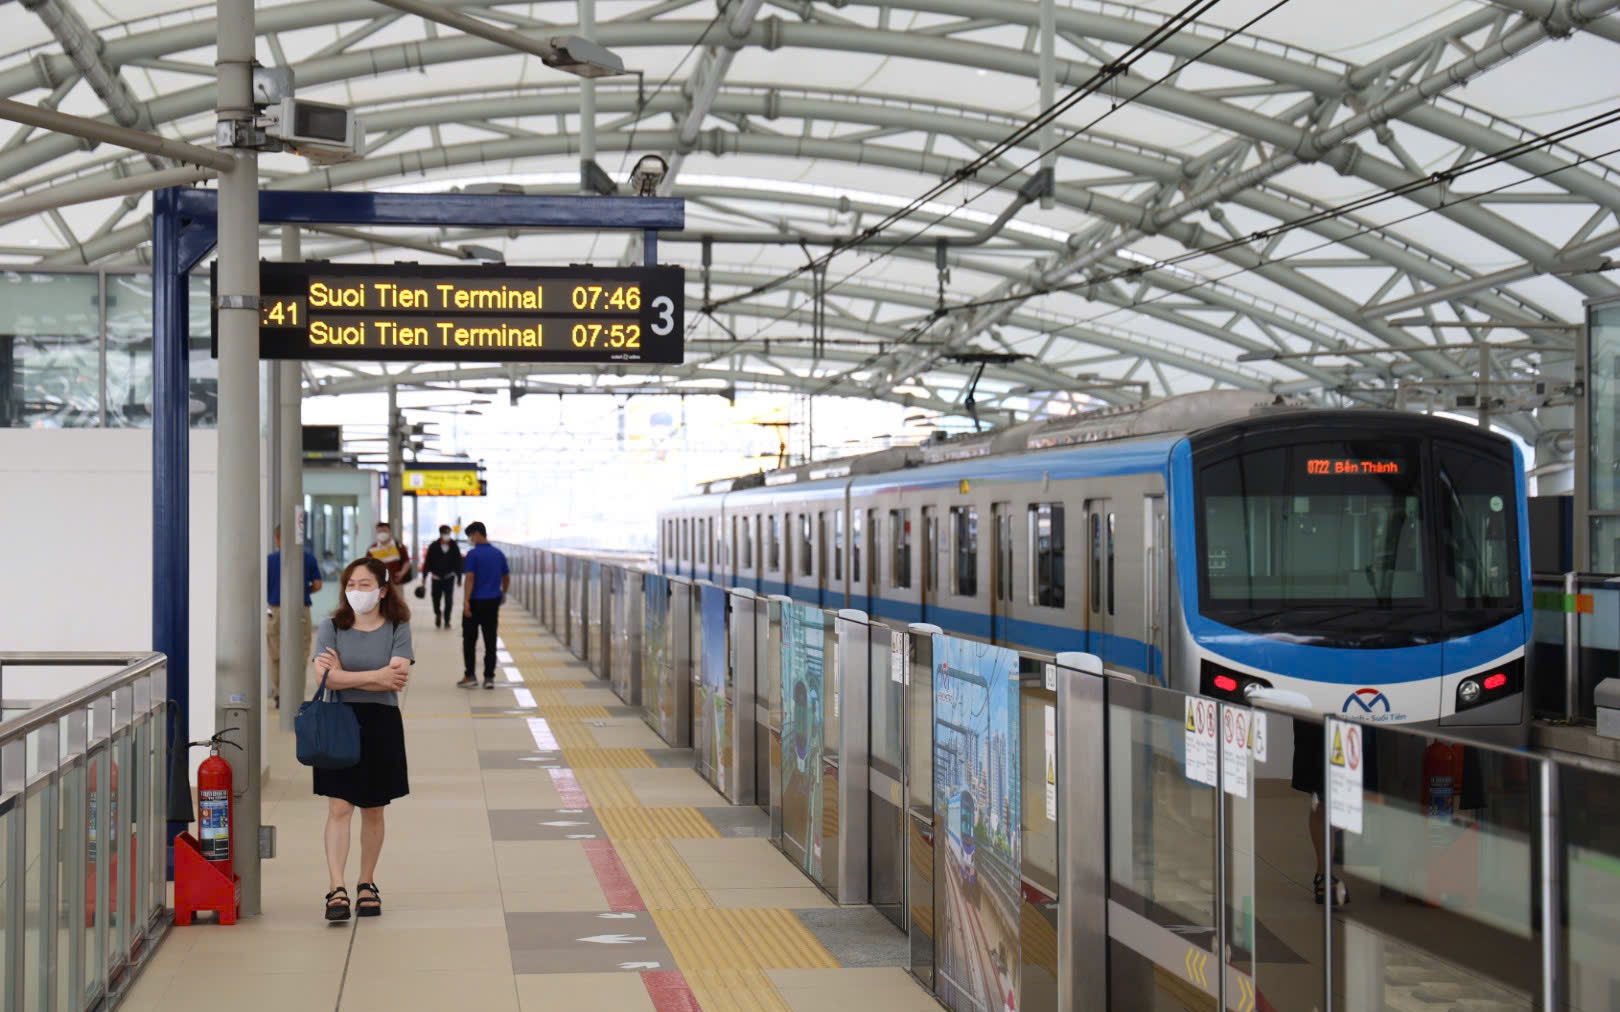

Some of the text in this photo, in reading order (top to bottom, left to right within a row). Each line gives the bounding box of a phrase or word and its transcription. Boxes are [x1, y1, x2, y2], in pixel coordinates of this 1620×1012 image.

[309, 283, 641, 310] Suoi Tien Terminal 07:46
[263, 302, 298, 326] :41
[651, 296, 675, 336] 3
[309, 321, 641, 348] Suoi Tien Terminal 07:52
